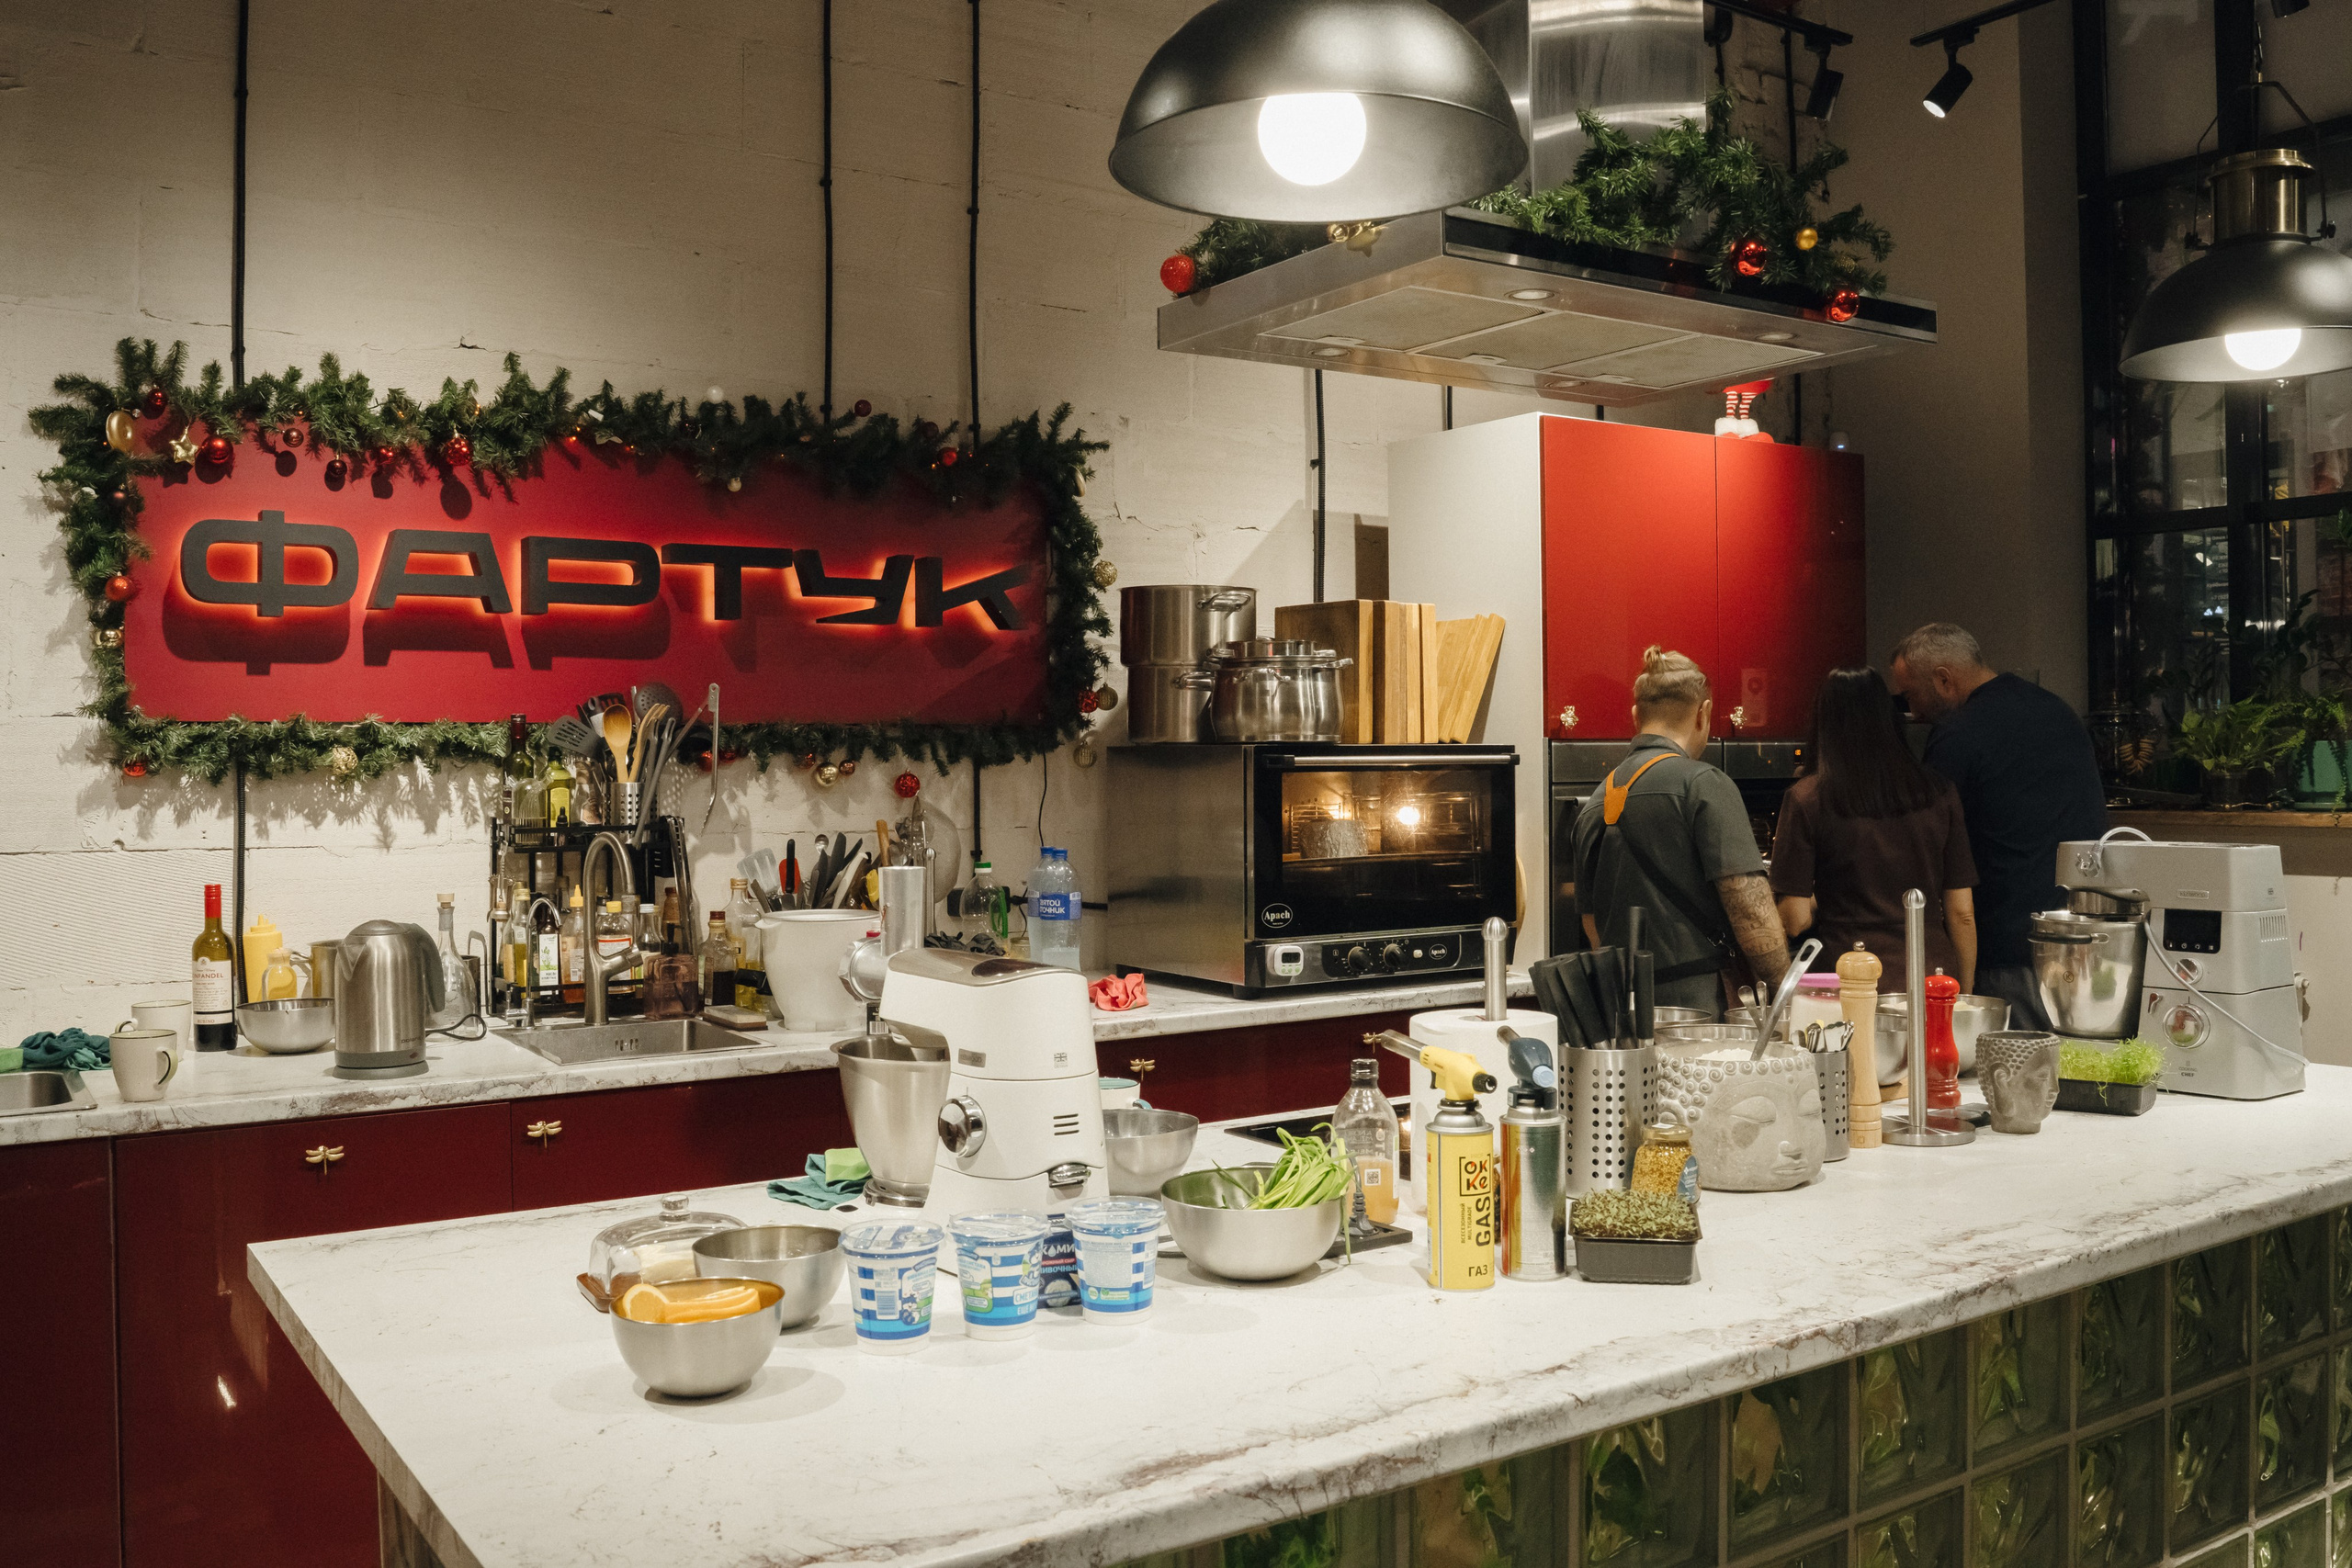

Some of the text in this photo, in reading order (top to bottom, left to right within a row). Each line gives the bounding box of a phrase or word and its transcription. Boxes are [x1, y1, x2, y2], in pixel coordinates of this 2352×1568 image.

[180, 510, 1029, 631] ФАРТУК
[1264, 910, 1291, 922] Apach
[1430, 948, 1446, 956] Apach
[1476, 1196, 1491, 1247] GAS
[1041, 1265, 1078, 1274] ИВОЧНЫ
[1468, 1264, 1488, 1278] ГАЗ
